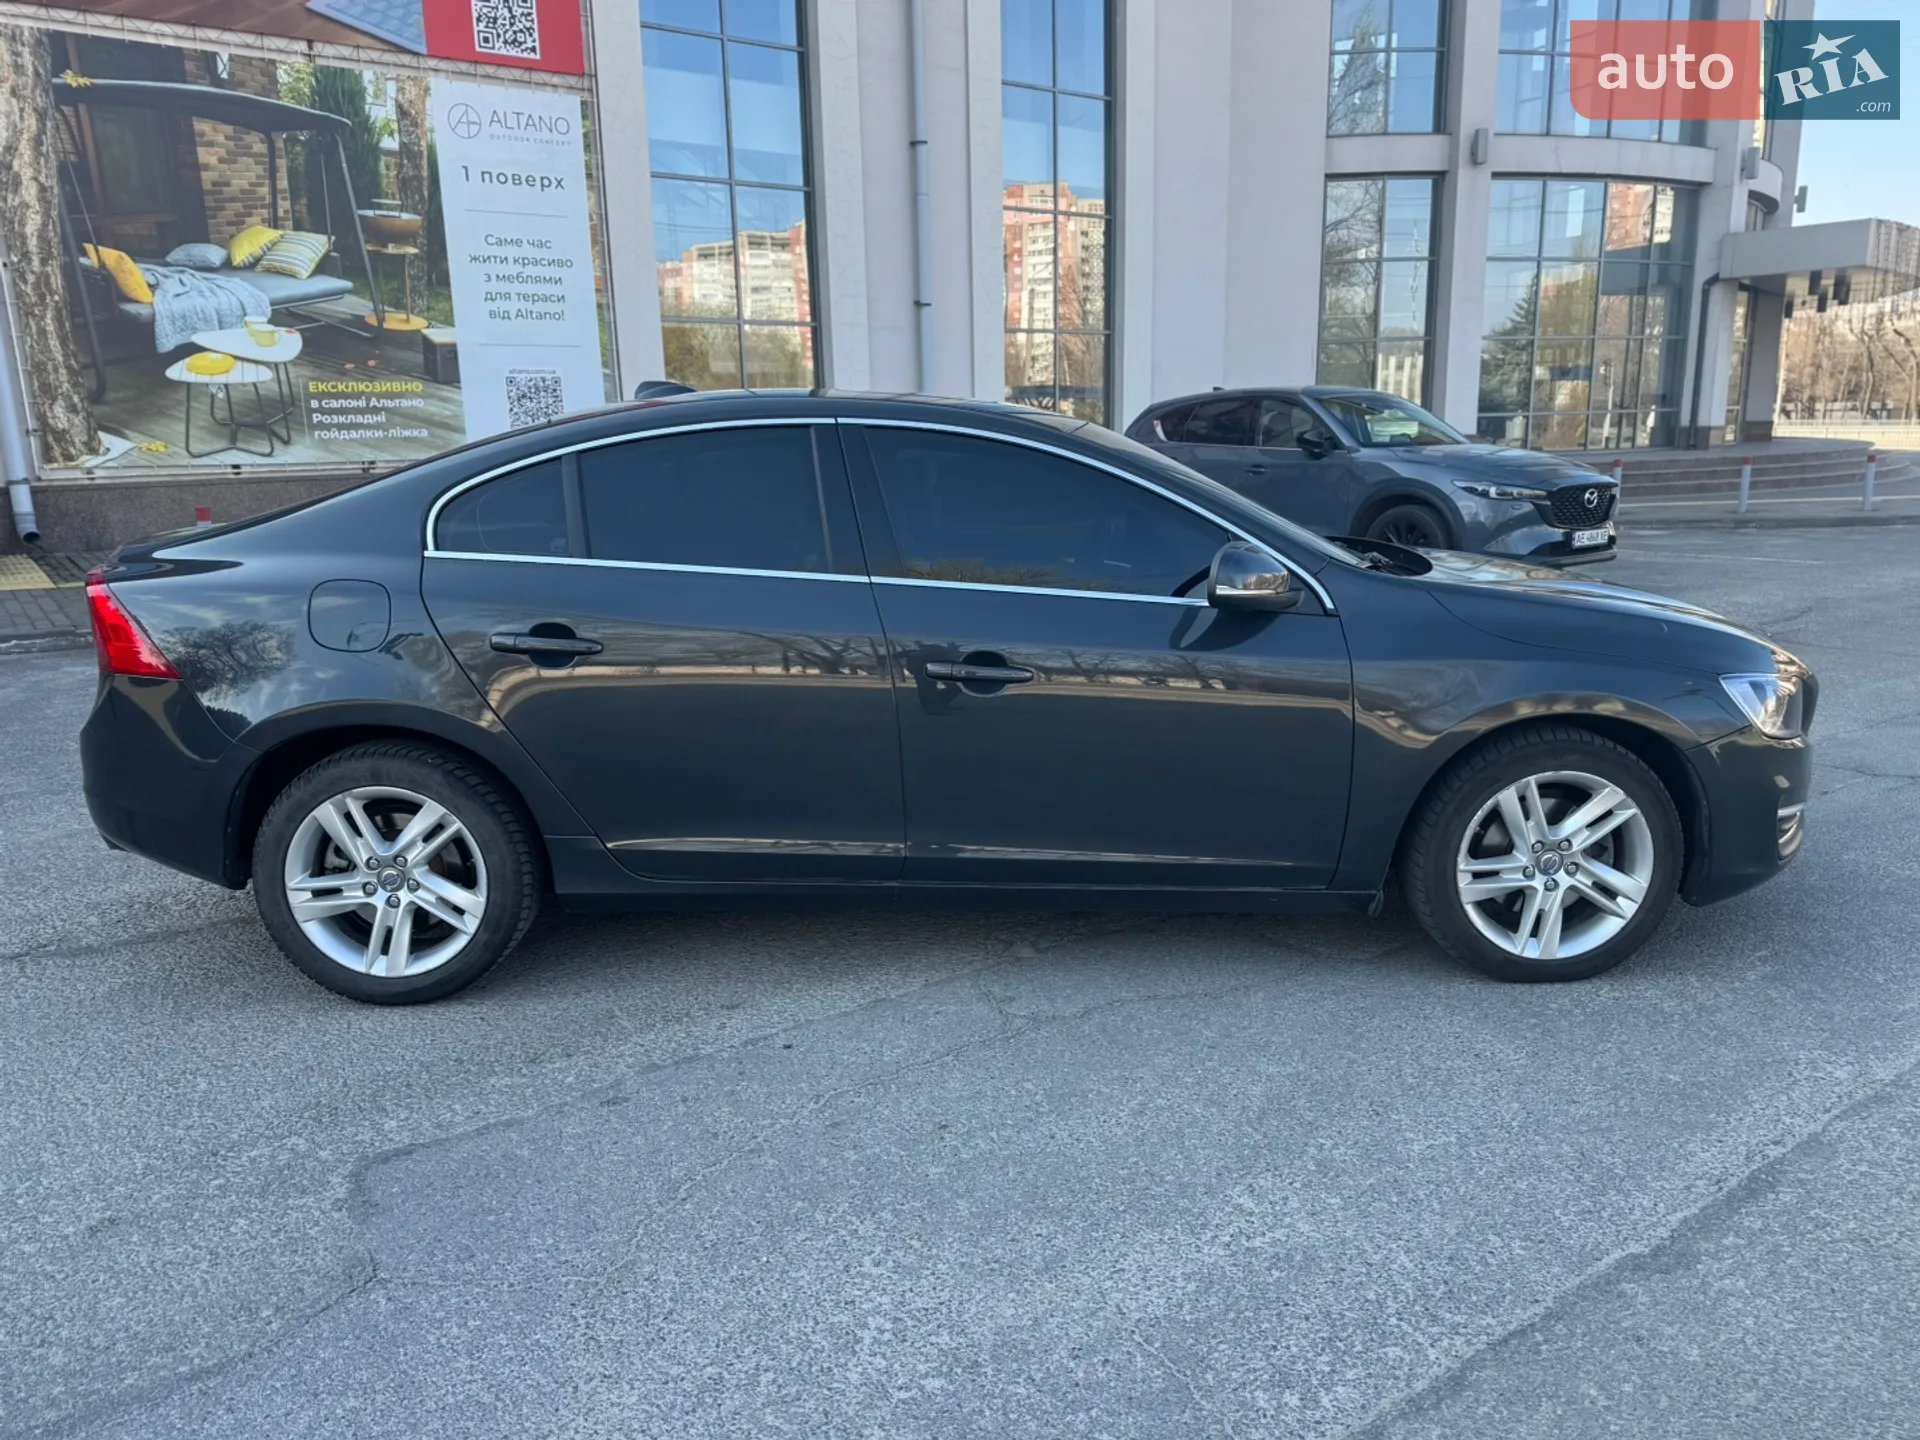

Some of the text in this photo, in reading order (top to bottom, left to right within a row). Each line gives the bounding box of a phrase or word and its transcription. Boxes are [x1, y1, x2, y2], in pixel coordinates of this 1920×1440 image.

[489, 109, 571, 136] ALTANO
[489, 133, 572, 147] OUTDOOR CONCEPT
[461, 165, 565, 192] 1 поверх
[484, 233, 552, 249] Саме час
[468, 253, 573, 269] жити красиво
[483, 271, 562, 285] з меблями
[484, 291, 565, 305] для тераси
[489, 307, 565, 321] від Altano!
[308, 381, 423, 392] ЕКСКЛЮЗИВНО
[310, 396, 424, 408] в салоні Альтано
[312, 411, 386, 424] Розкладні
[314, 427, 428, 440] гойдалки-ліжка
